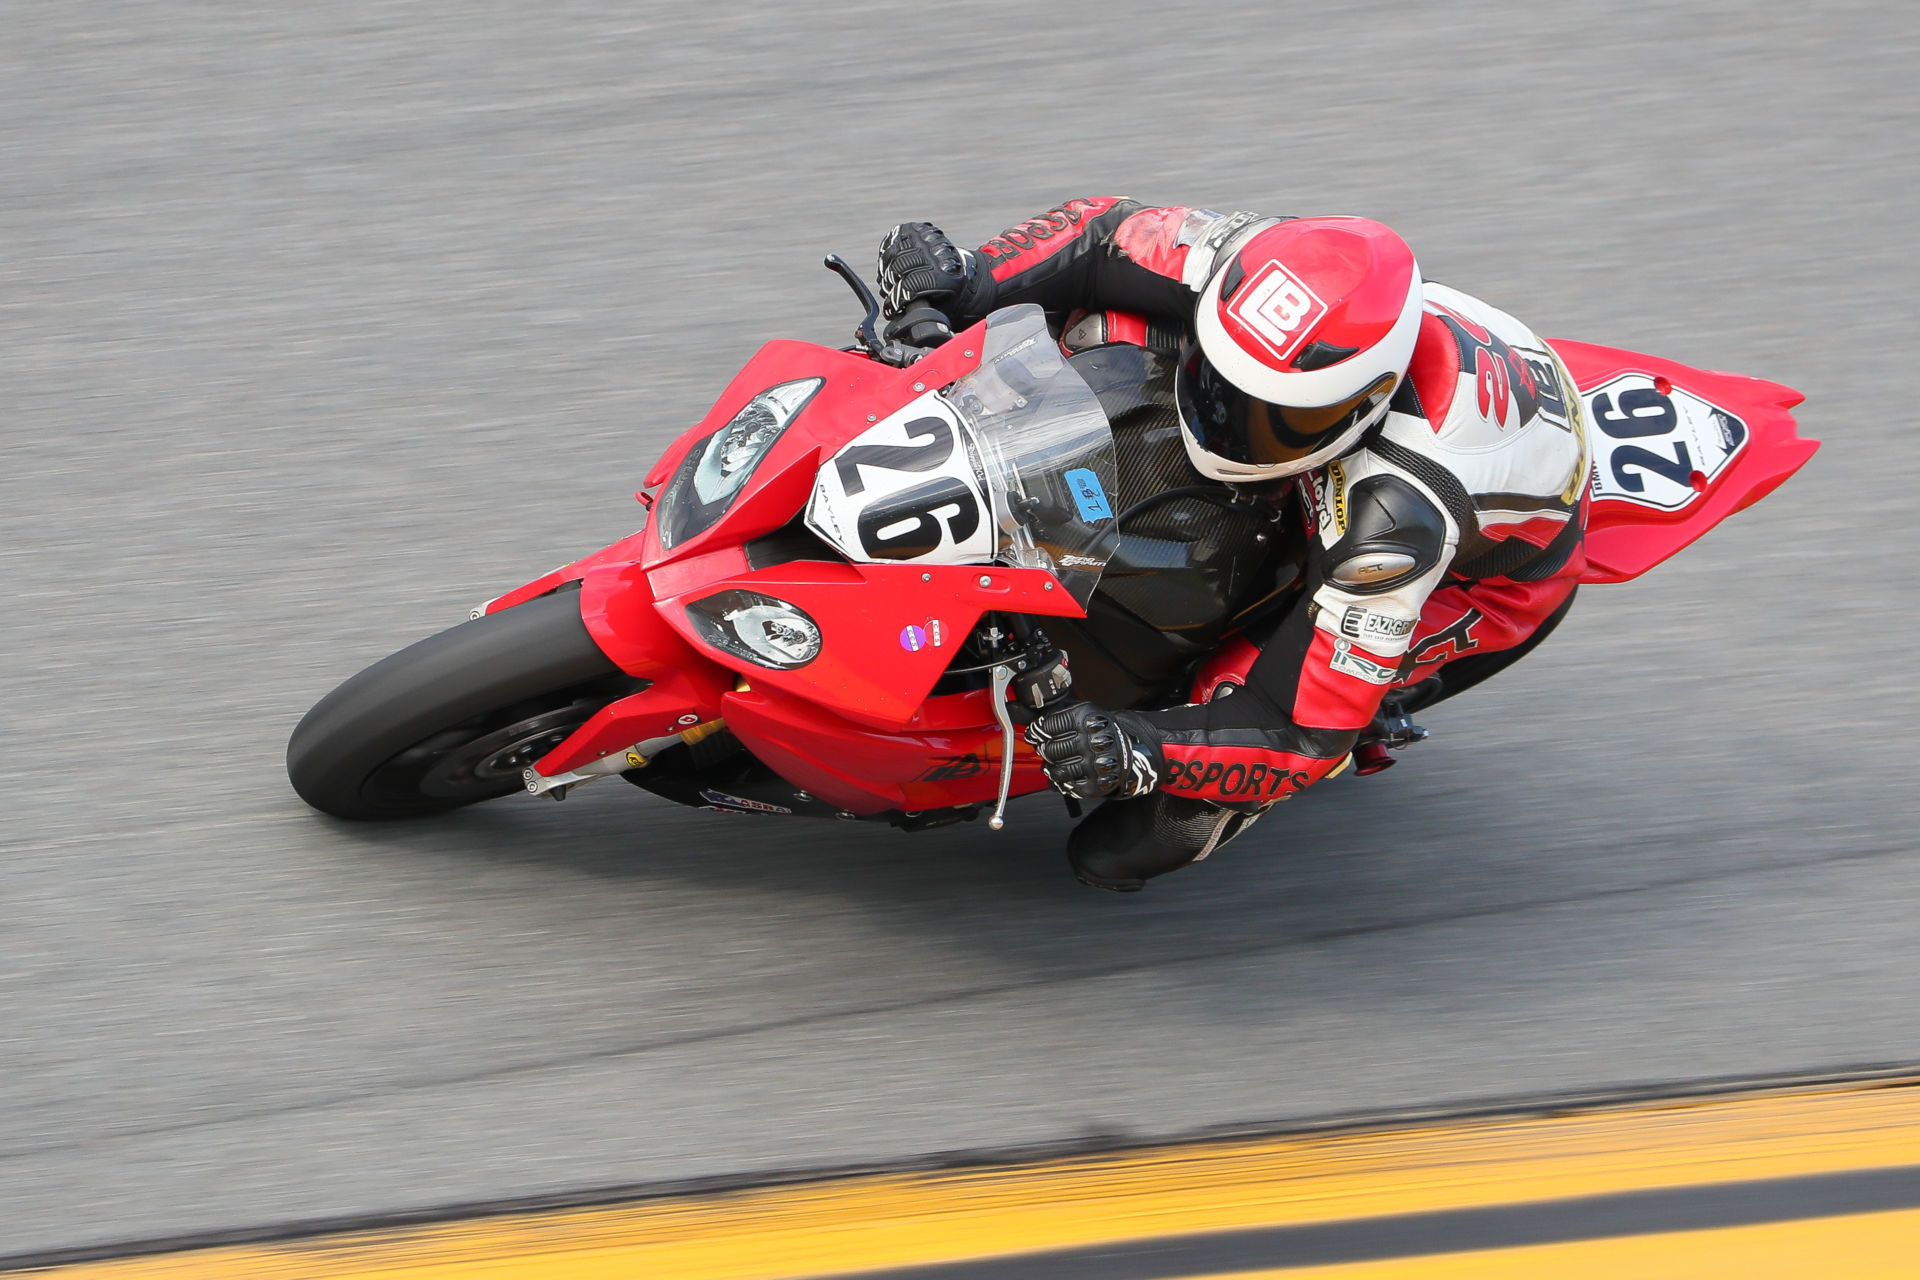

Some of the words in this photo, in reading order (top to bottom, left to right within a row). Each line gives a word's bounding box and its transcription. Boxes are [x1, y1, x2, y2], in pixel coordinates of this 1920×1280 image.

[835, 416, 979, 560] 26
[1592, 387, 1692, 493] 26
[1331, 465, 1346, 530] DUNLOP
